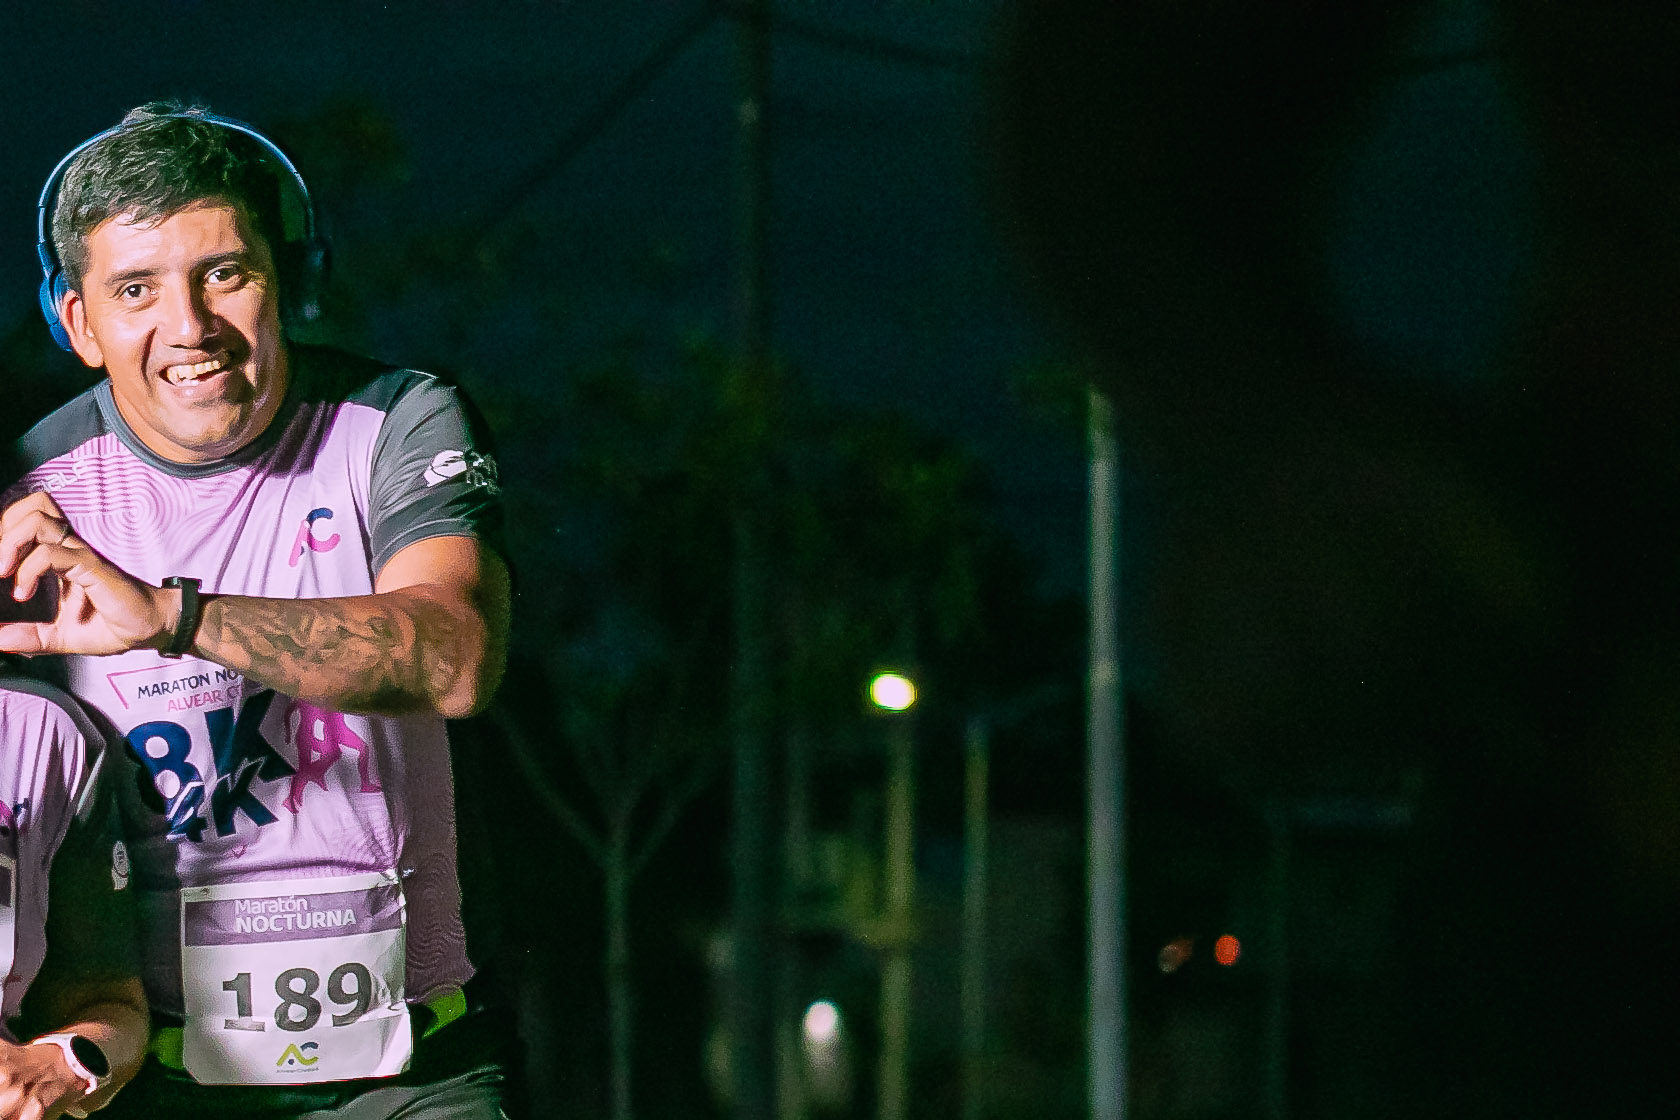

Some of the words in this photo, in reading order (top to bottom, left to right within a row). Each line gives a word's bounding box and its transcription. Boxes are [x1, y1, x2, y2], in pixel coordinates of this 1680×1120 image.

[138, 672, 211, 699] MARATON
[168, 689, 221, 711] ALVEAR
[234, 895, 308, 915] Maratón
[235, 908, 357, 934] NOCTURNA
[222, 962, 372, 1032] 189
